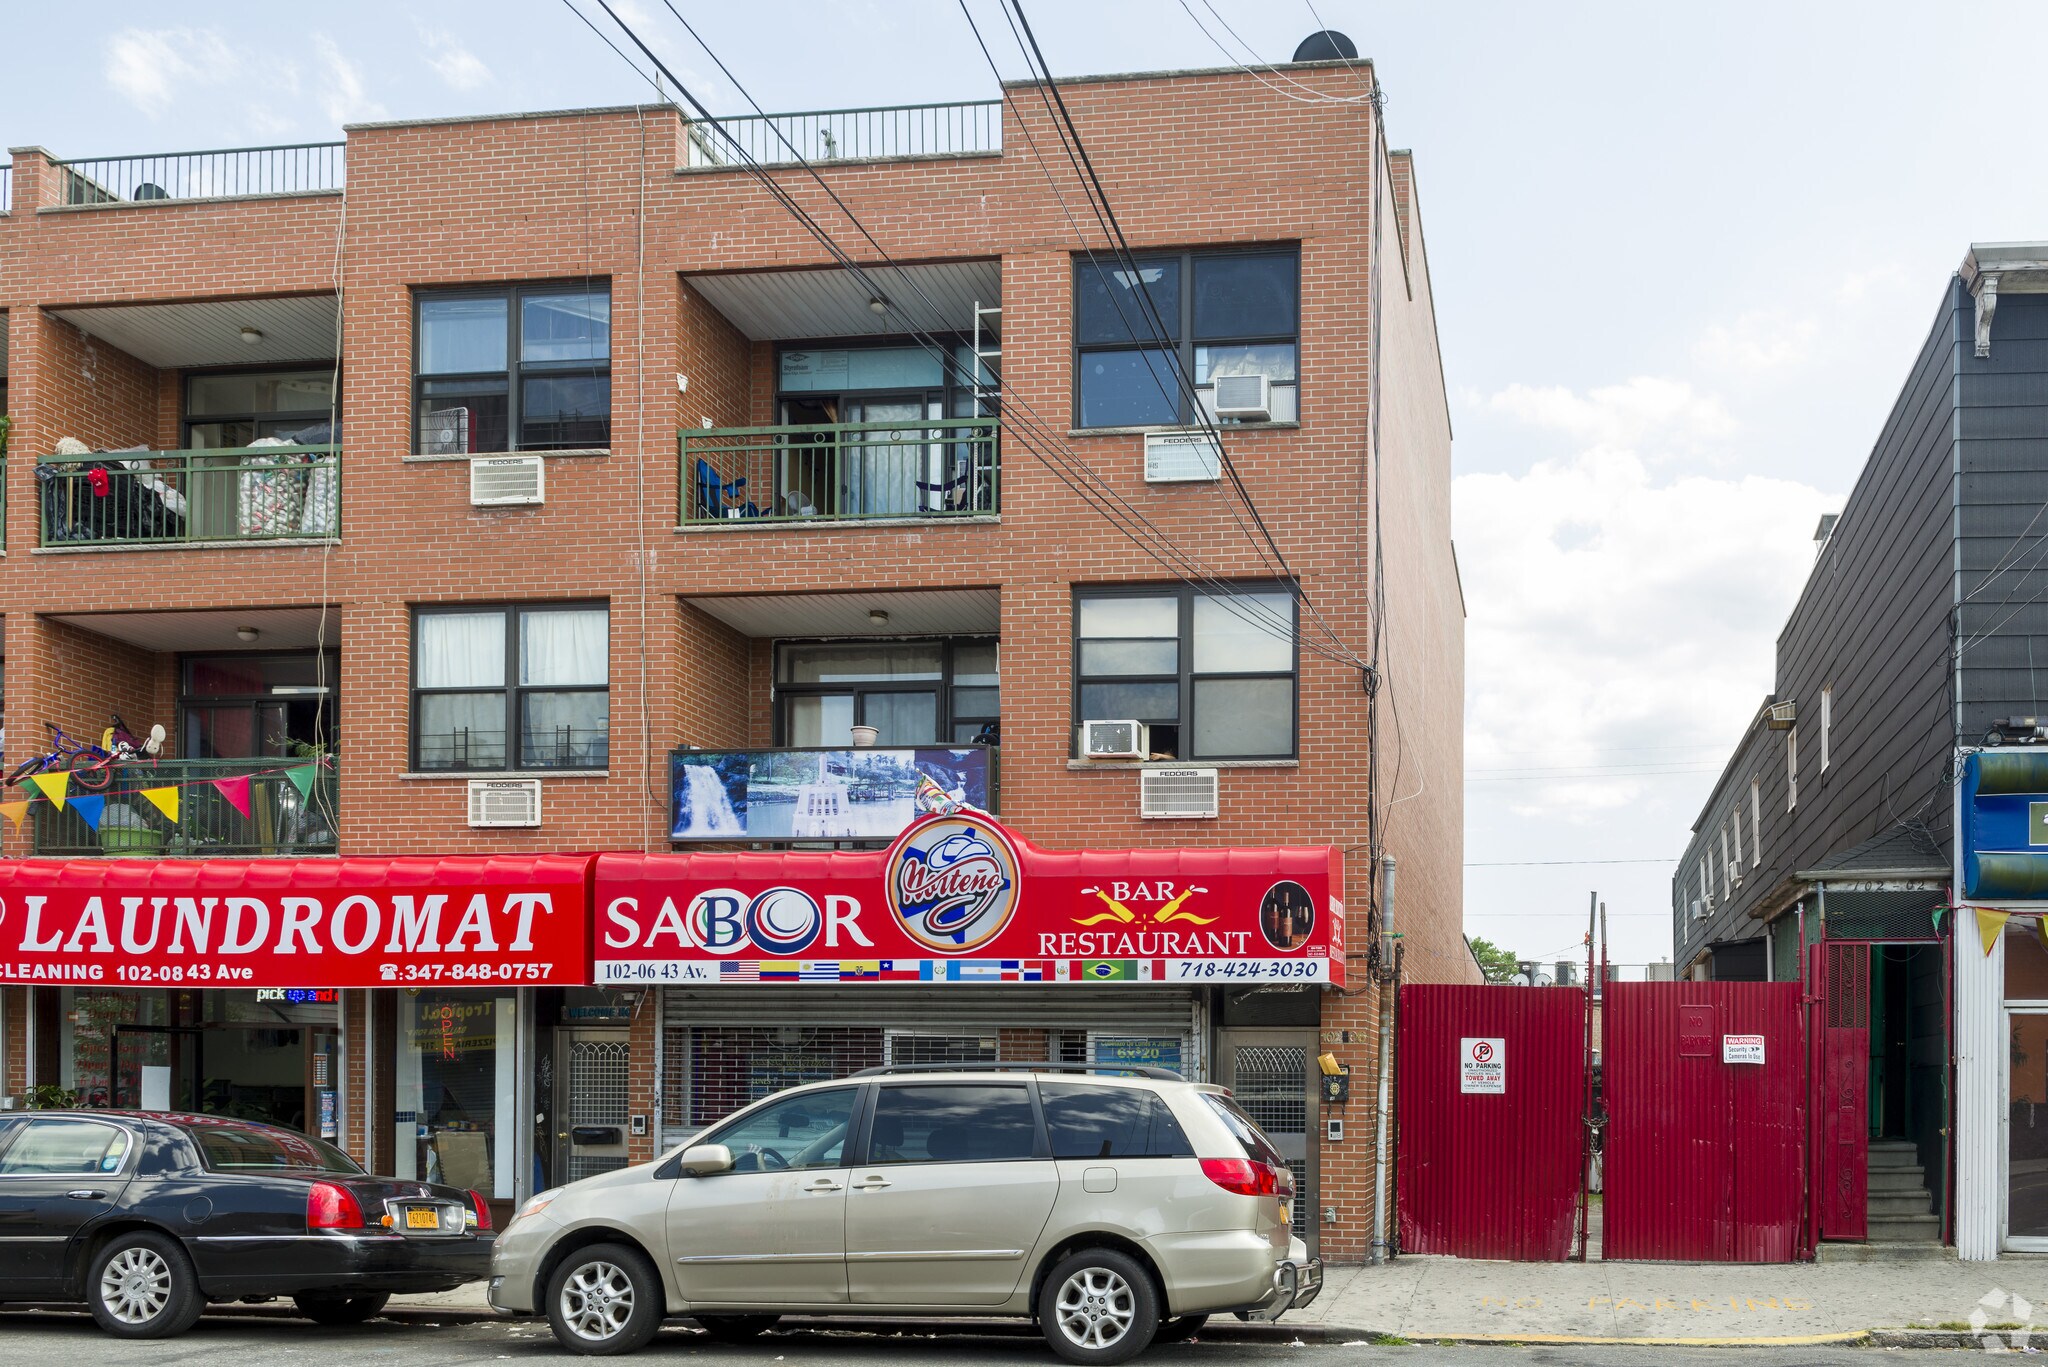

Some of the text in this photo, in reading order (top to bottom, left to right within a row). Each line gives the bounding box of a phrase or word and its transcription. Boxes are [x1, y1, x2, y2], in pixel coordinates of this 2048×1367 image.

[902, 857, 1002, 903] Norteño
[1111, 881, 1176, 901] BAR
[18, 893, 554, 955] LAUNDROMAT
[604, 887, 875, 955] SABOR
[1037, 931, 1252, 956] RESTAURANT
[0, 963, 254, 982] LEANING 102-08 43 Ave
[604, 963, 708, 980] 102-06 43 Av.
[1180, 961, 1319, 978] 718-424-3030
[256, 987, 286, 1002] pick
[569, 1007, 615, 1018] WELCOME
[1689, 1015, 1704, 1028] NO
[441, 1006, 455, 1059] OPEN
[1728, 1046, 1747, 1054] Security
[1481, 1295, 1815, 1312] NO PARKING
